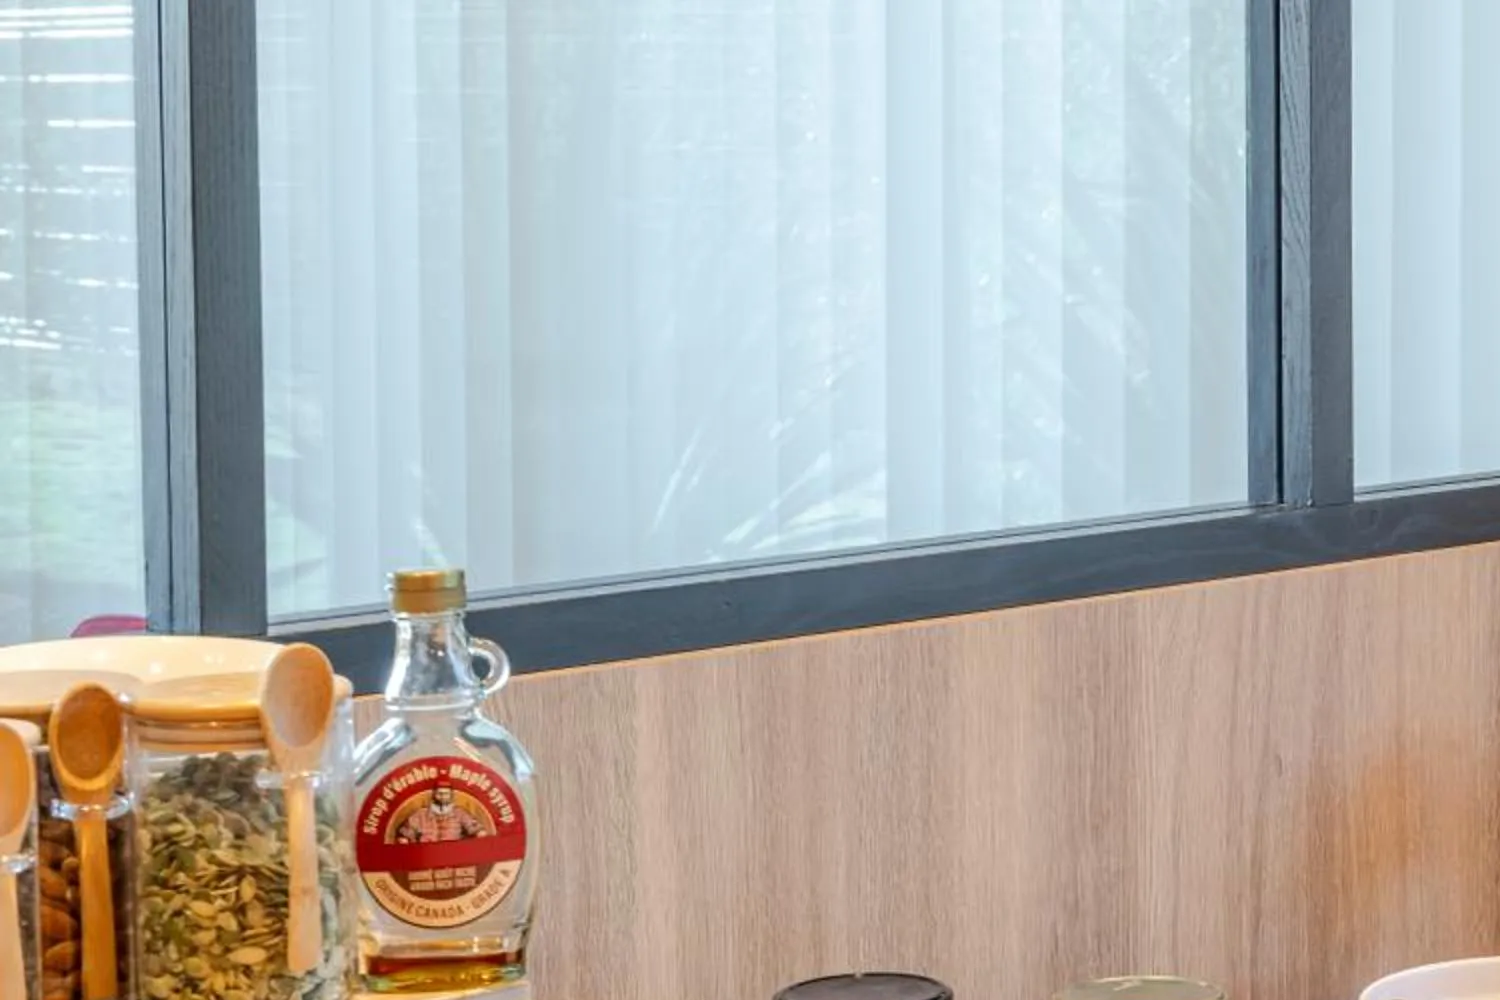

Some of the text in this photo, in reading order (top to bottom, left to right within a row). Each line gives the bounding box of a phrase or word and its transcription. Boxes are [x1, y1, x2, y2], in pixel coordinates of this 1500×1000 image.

[363, 798, 388, 835] Sirop
[448, 763, 491, 791] Maple
[487, 787, 516, 823] syrup
[415, 905, 464, 919] CANADA
